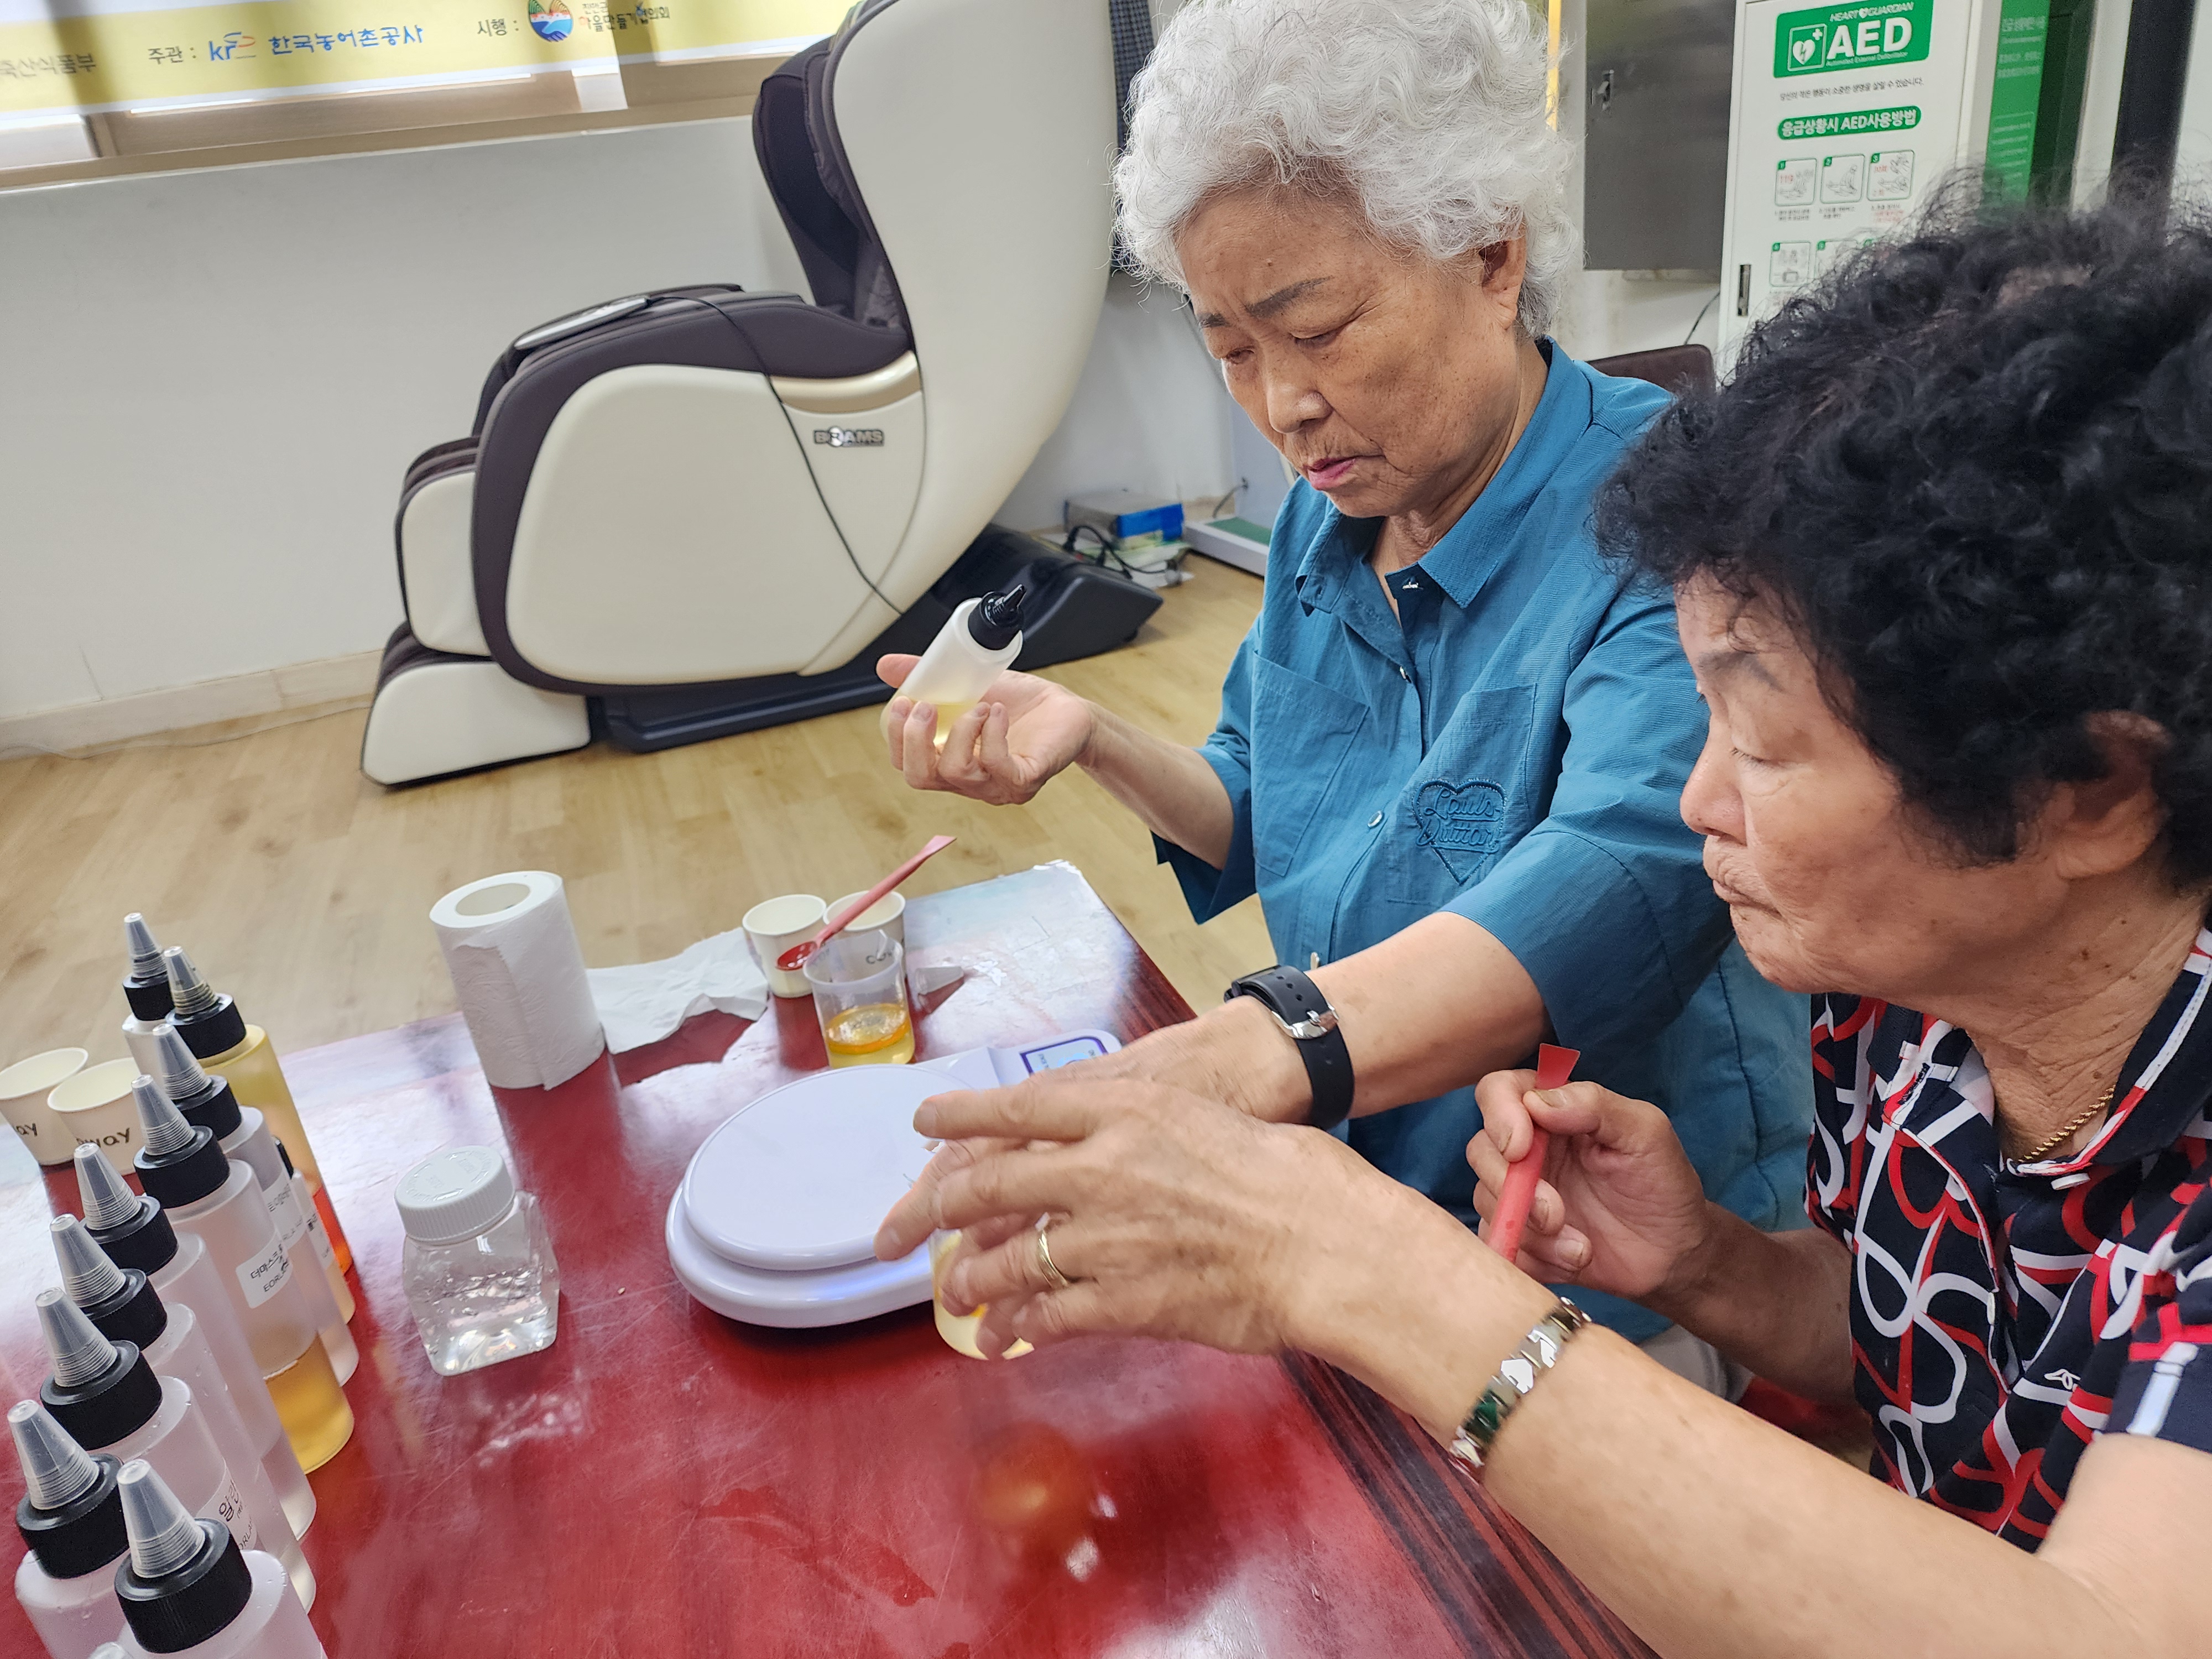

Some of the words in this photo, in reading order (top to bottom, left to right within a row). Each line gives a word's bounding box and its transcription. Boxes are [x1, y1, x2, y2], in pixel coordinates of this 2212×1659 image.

[268, 24, 424, 55] 한국농어촌공사
[477, 18, 507, 37] 시행
[1827, 17, 1912, 60] AED
[148, 45, 184, 65] 주관
[1782, 117, 1838, 137] 응급상황시
[1840, 109, 1917, 131] AED사용방법
